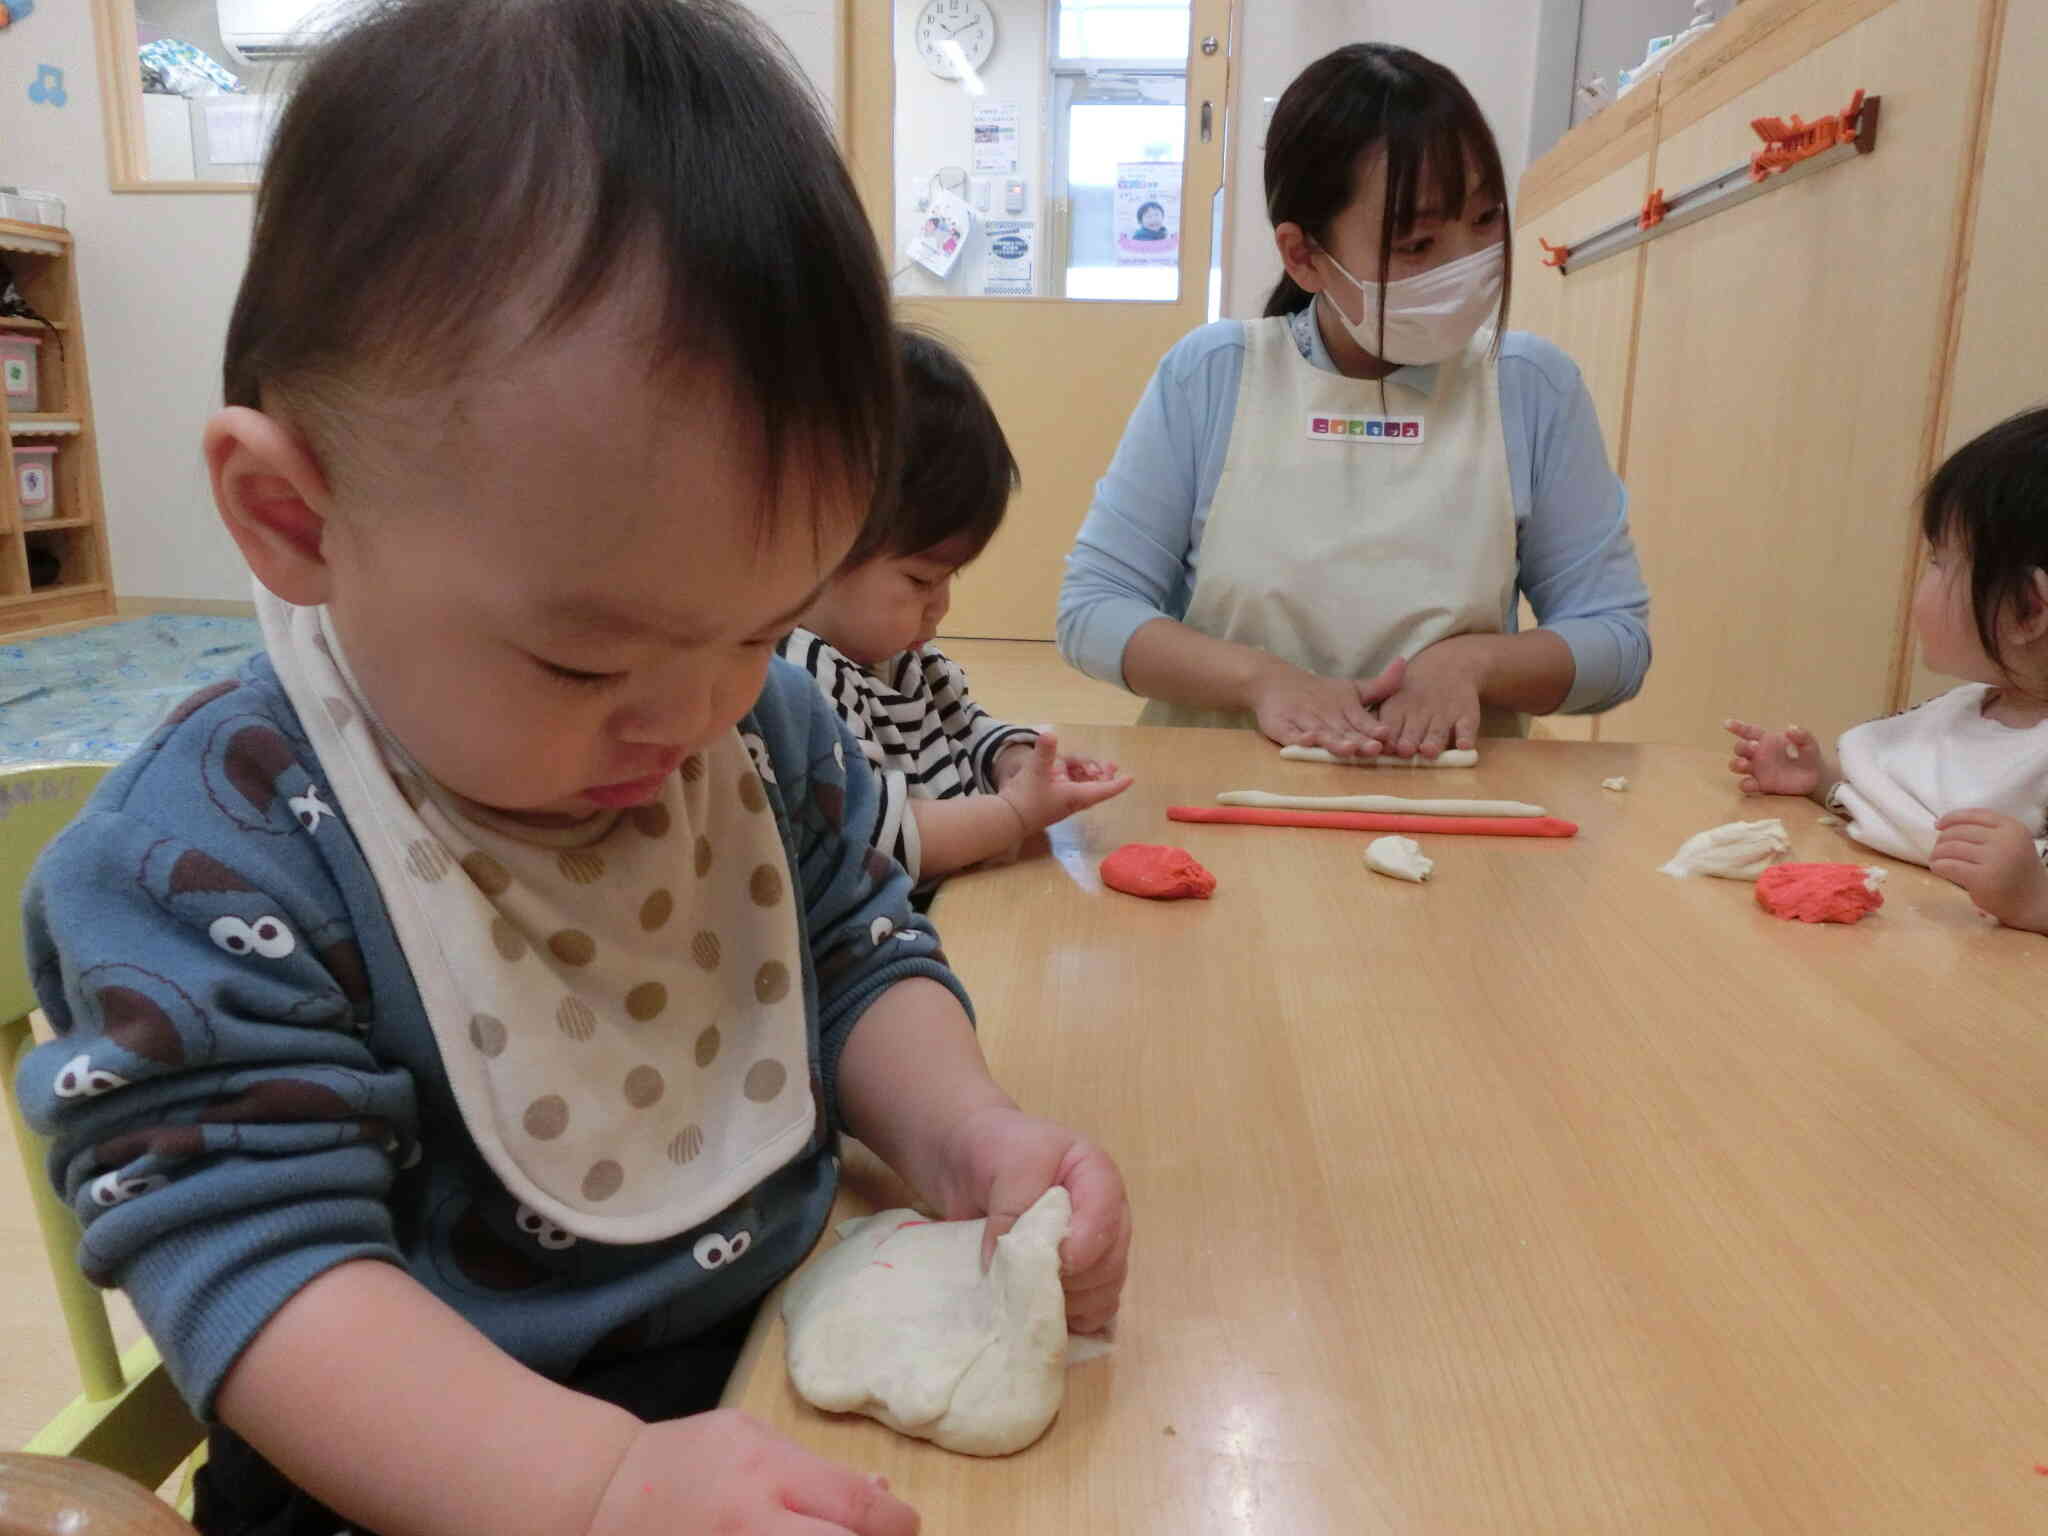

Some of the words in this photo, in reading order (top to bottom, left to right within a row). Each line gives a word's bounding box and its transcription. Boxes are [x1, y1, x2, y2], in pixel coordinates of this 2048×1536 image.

[936, 3, 944, 14] 11
[948, 0, 959, 10] 12
[927, 15, 935, 24] 10
